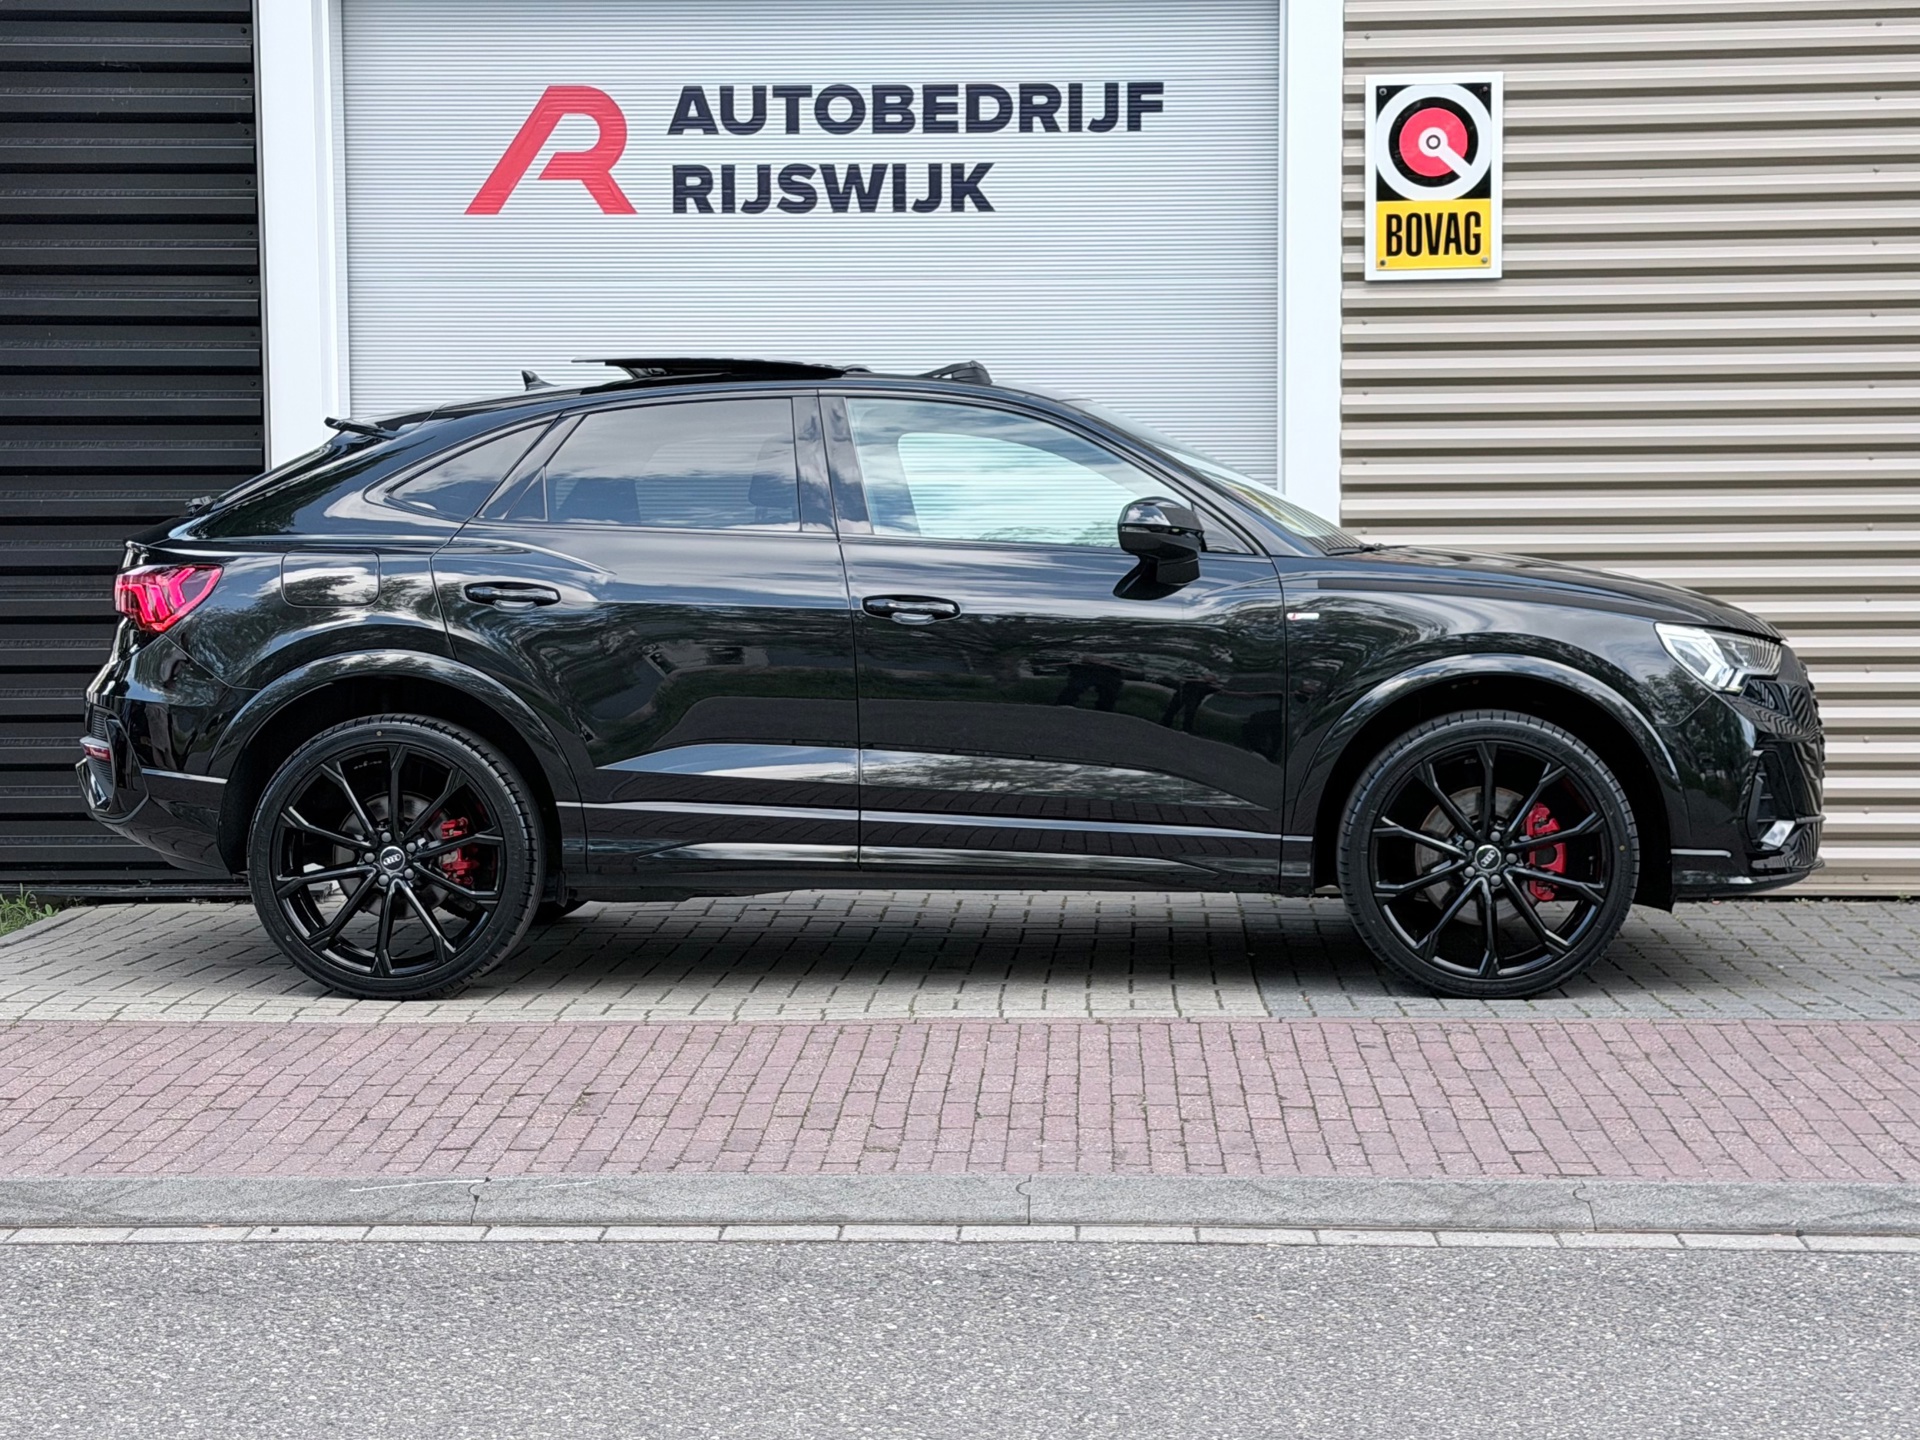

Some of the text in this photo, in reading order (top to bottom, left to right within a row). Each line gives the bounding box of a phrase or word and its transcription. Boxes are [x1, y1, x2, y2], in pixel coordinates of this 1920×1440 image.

[667, 82, 1164, 136] AUTOBEDRIJF
[672, 162, 995, 215] RIJSWIJK
[1386, 211, 1482, 257] BOVAG
